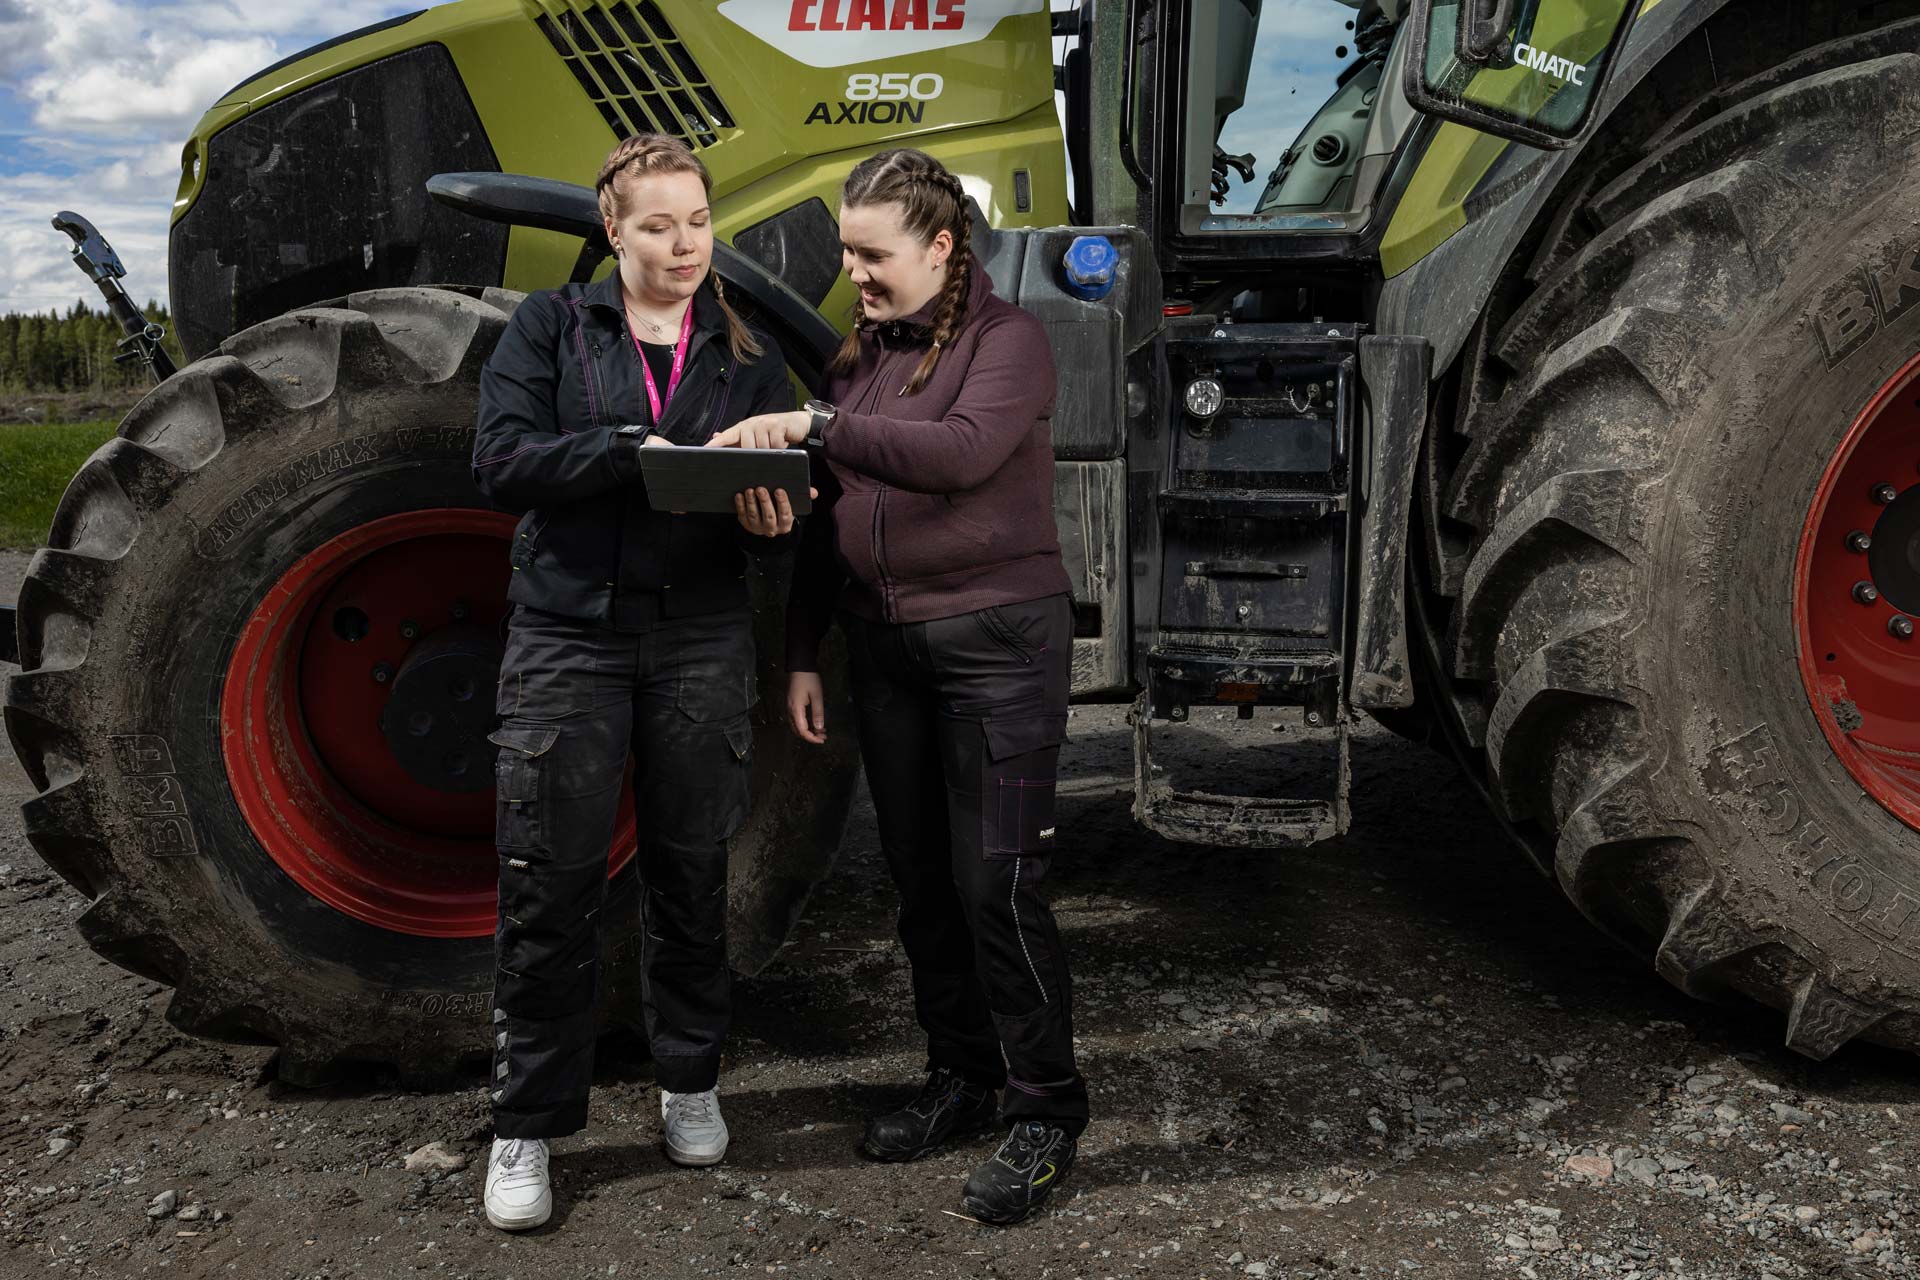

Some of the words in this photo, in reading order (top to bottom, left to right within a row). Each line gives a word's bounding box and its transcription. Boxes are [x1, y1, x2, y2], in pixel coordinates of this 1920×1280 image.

[788, 0, 966, 31] CLAAS
[1513, 42, 1587, 87] CMATIC
[845, 73, 944, 101] 850
[803, 101, 925, 125] AXION
